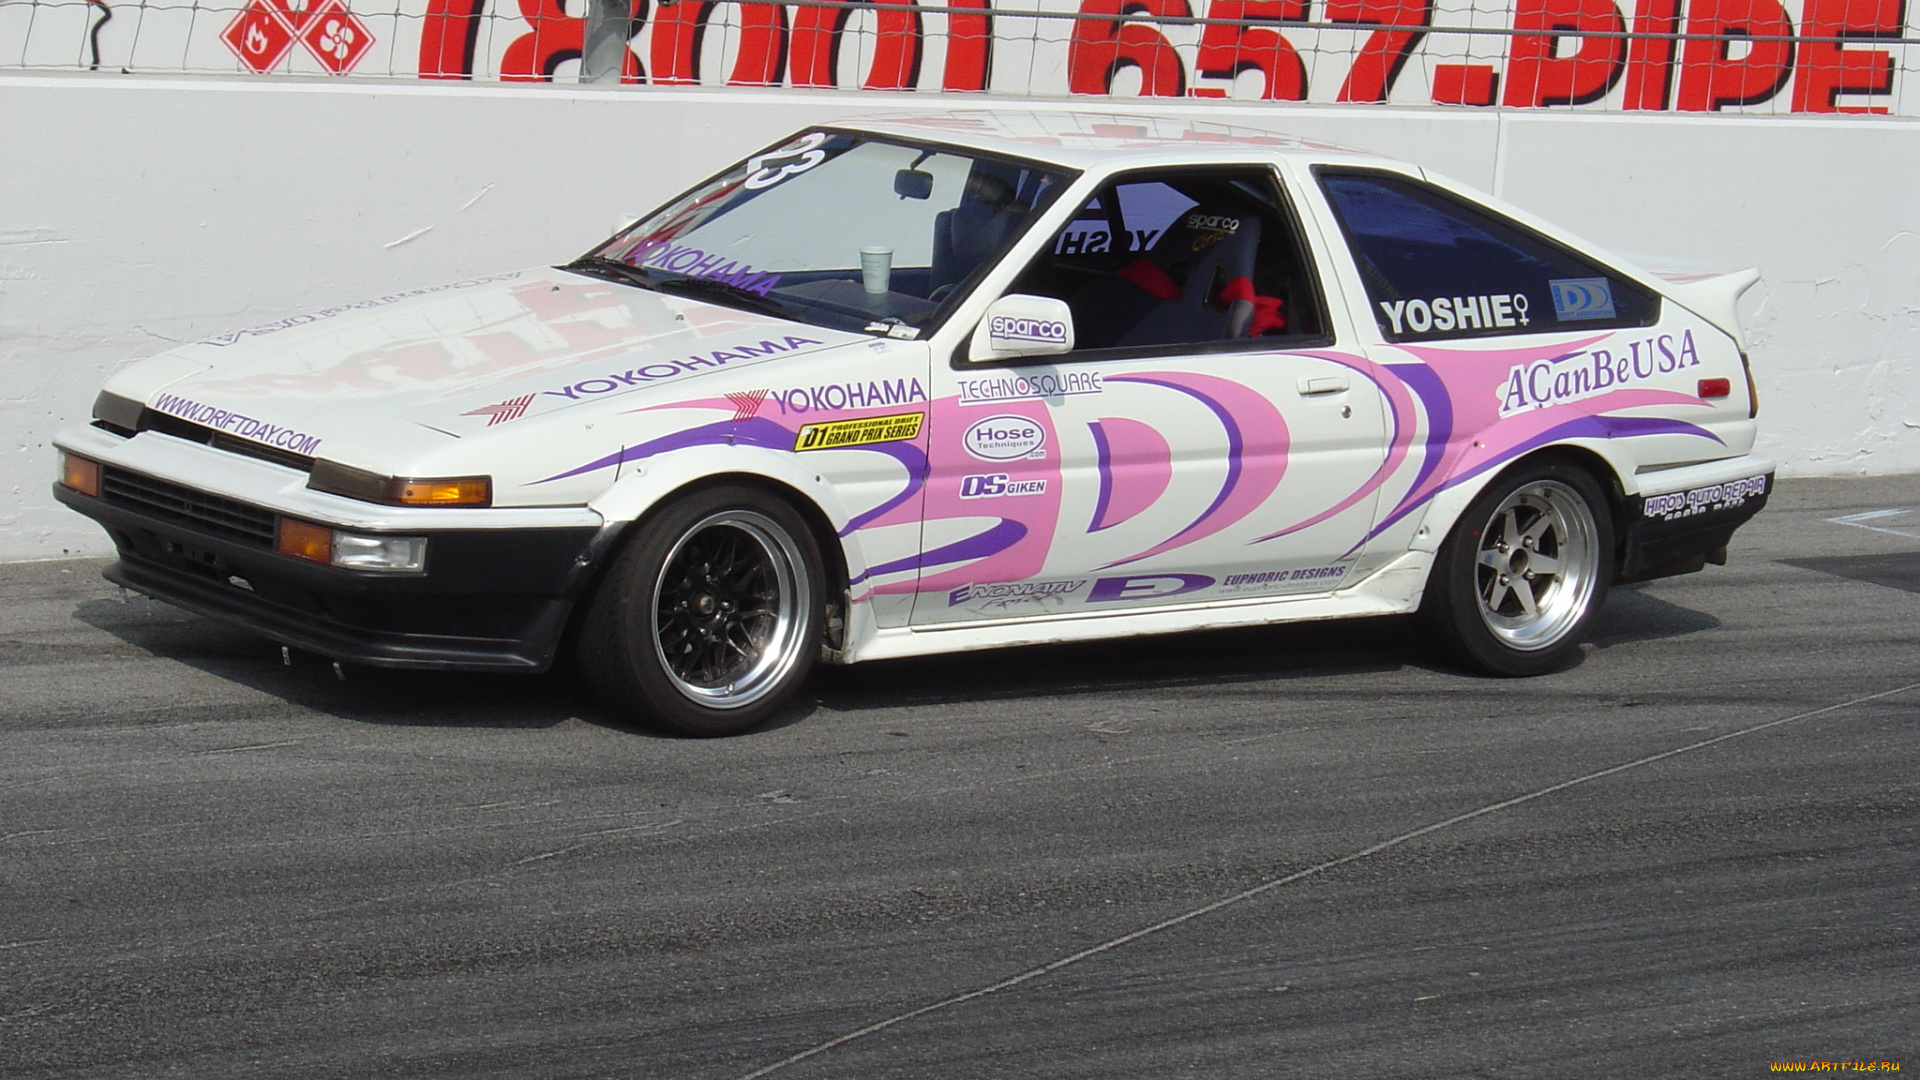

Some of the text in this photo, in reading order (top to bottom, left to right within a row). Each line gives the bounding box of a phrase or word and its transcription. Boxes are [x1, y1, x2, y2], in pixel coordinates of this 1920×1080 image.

[745, 132, 825, 189] 23
[1187, 214, 1239, 234] sparco
[621, 239, 781, 297] YOKOHAMA
[992, 314, 1066, 342] sparco
[1380, 294, 1516, 334] YOSHIE
[543, 335, 824, 401] YOKOHAMA
[1502, 329, 1701, 413] ACanBeUSA
[772, 377, 928, 416] YOKOHAMA
[958, 371, 1103, 400] TECHNOSQUARE
[155, 393, 322, 455] WWW.DRIFTDAY.COM
[802, 426, 829, 448] D1
[826, 424, 918, 446] GRAND PRIX SERIES
[831, 416, 920, 431] PROFESSIONAL DRIFT
[976, 428, 1035, 441] Hose
[977, 440, 1035, 450] Techniques
[961, 475, 1046, 497] OS GIKEN
[1687, 485, 1723, 510] AUTO
[1722, 475, 1767, 500] REPAIR
[1223, 566, 1347, 586] EUPHORIC DESIGNS
